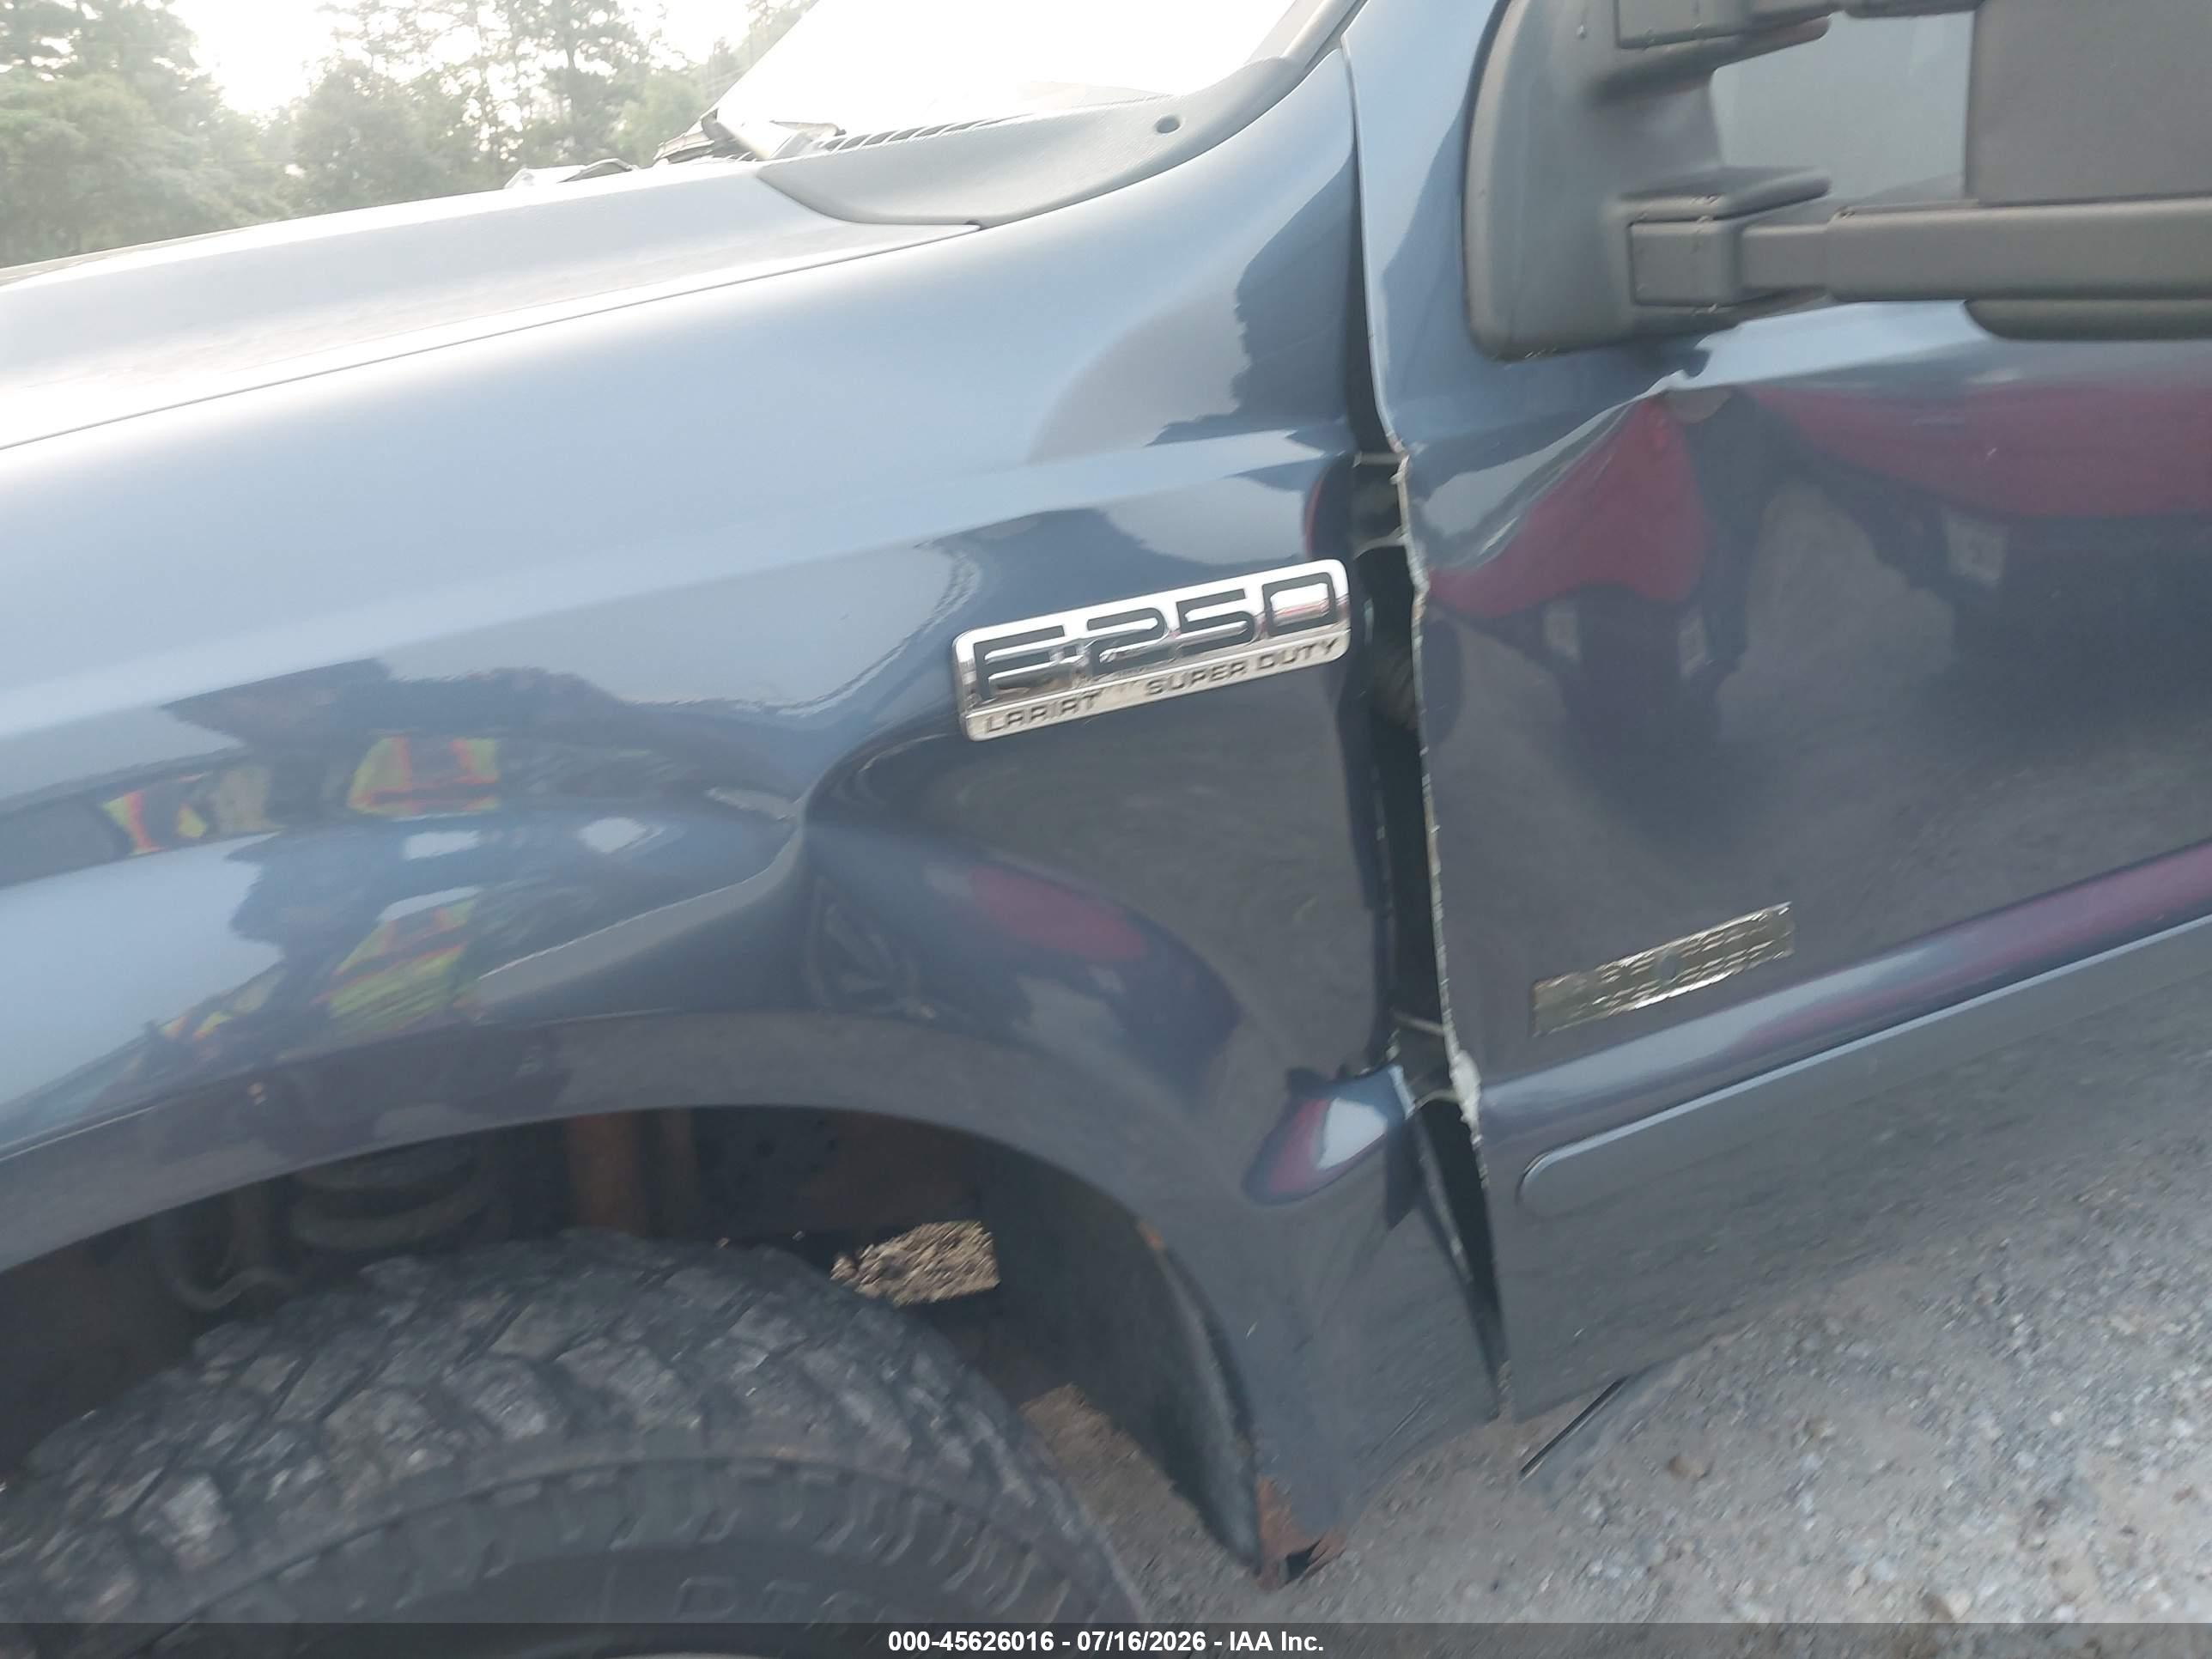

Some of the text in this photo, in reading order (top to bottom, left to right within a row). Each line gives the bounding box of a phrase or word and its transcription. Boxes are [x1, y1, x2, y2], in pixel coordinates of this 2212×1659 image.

[985, 638, 1339, 732] LARIAT SUPER DUTY
